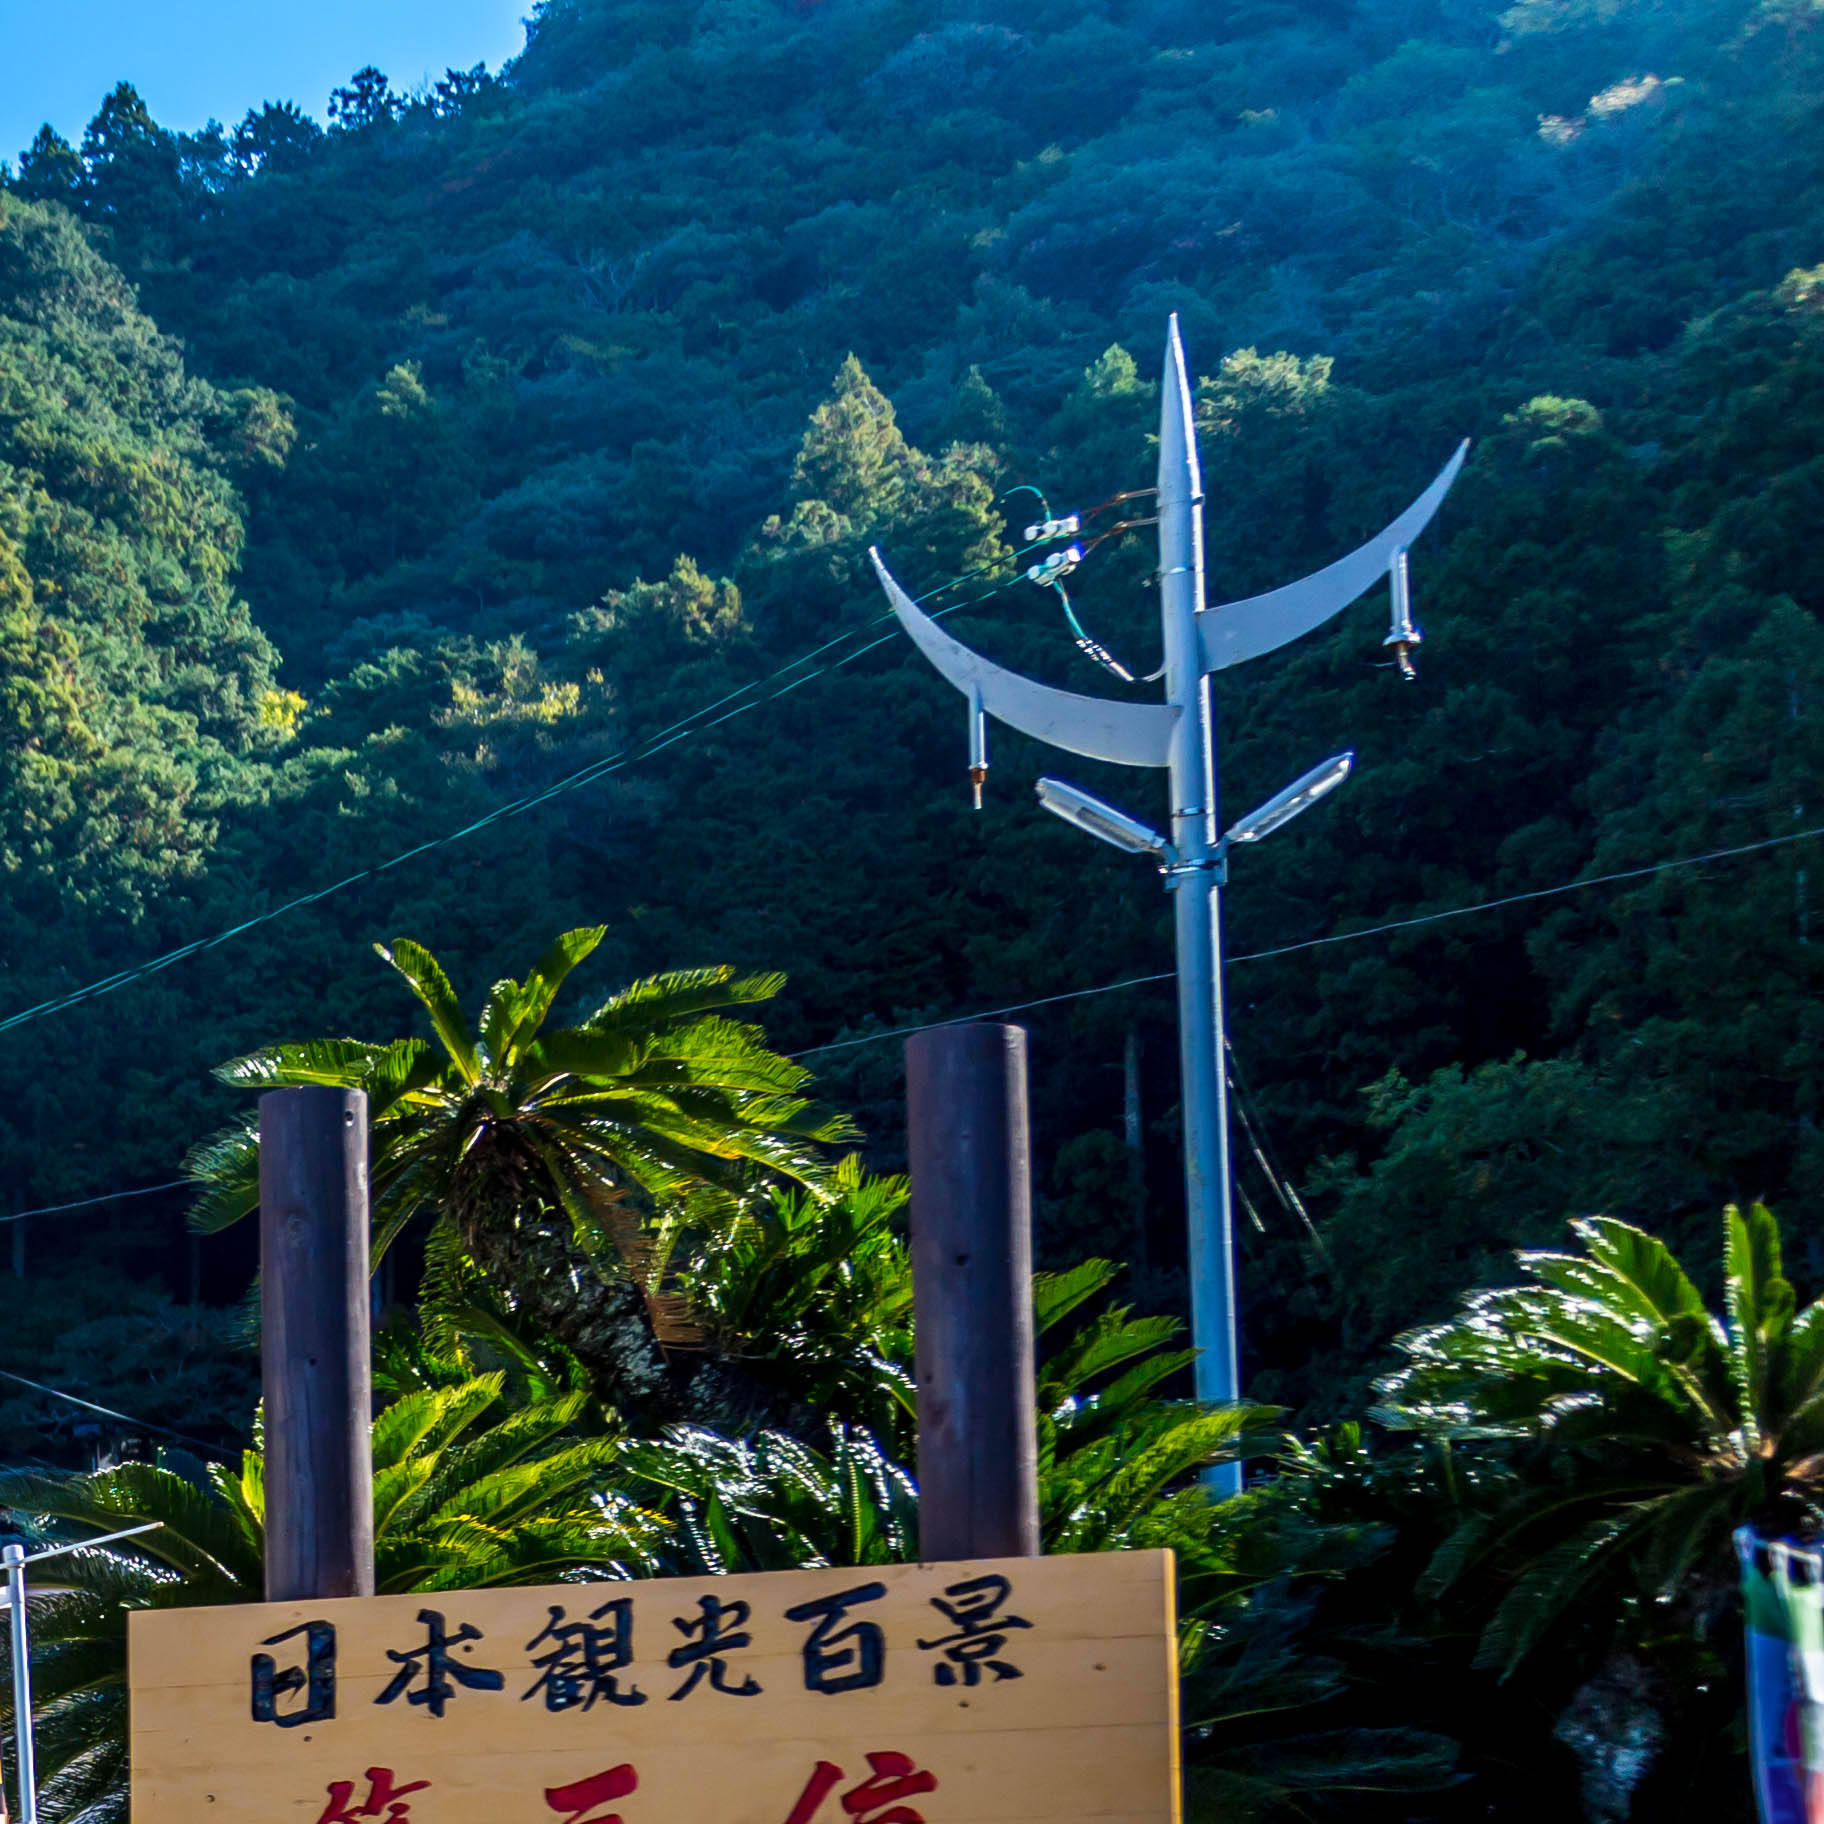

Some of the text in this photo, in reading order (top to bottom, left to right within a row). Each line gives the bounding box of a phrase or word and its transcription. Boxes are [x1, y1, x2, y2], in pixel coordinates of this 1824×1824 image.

[249, 1571, 1036, 1728] 日本観光百景
